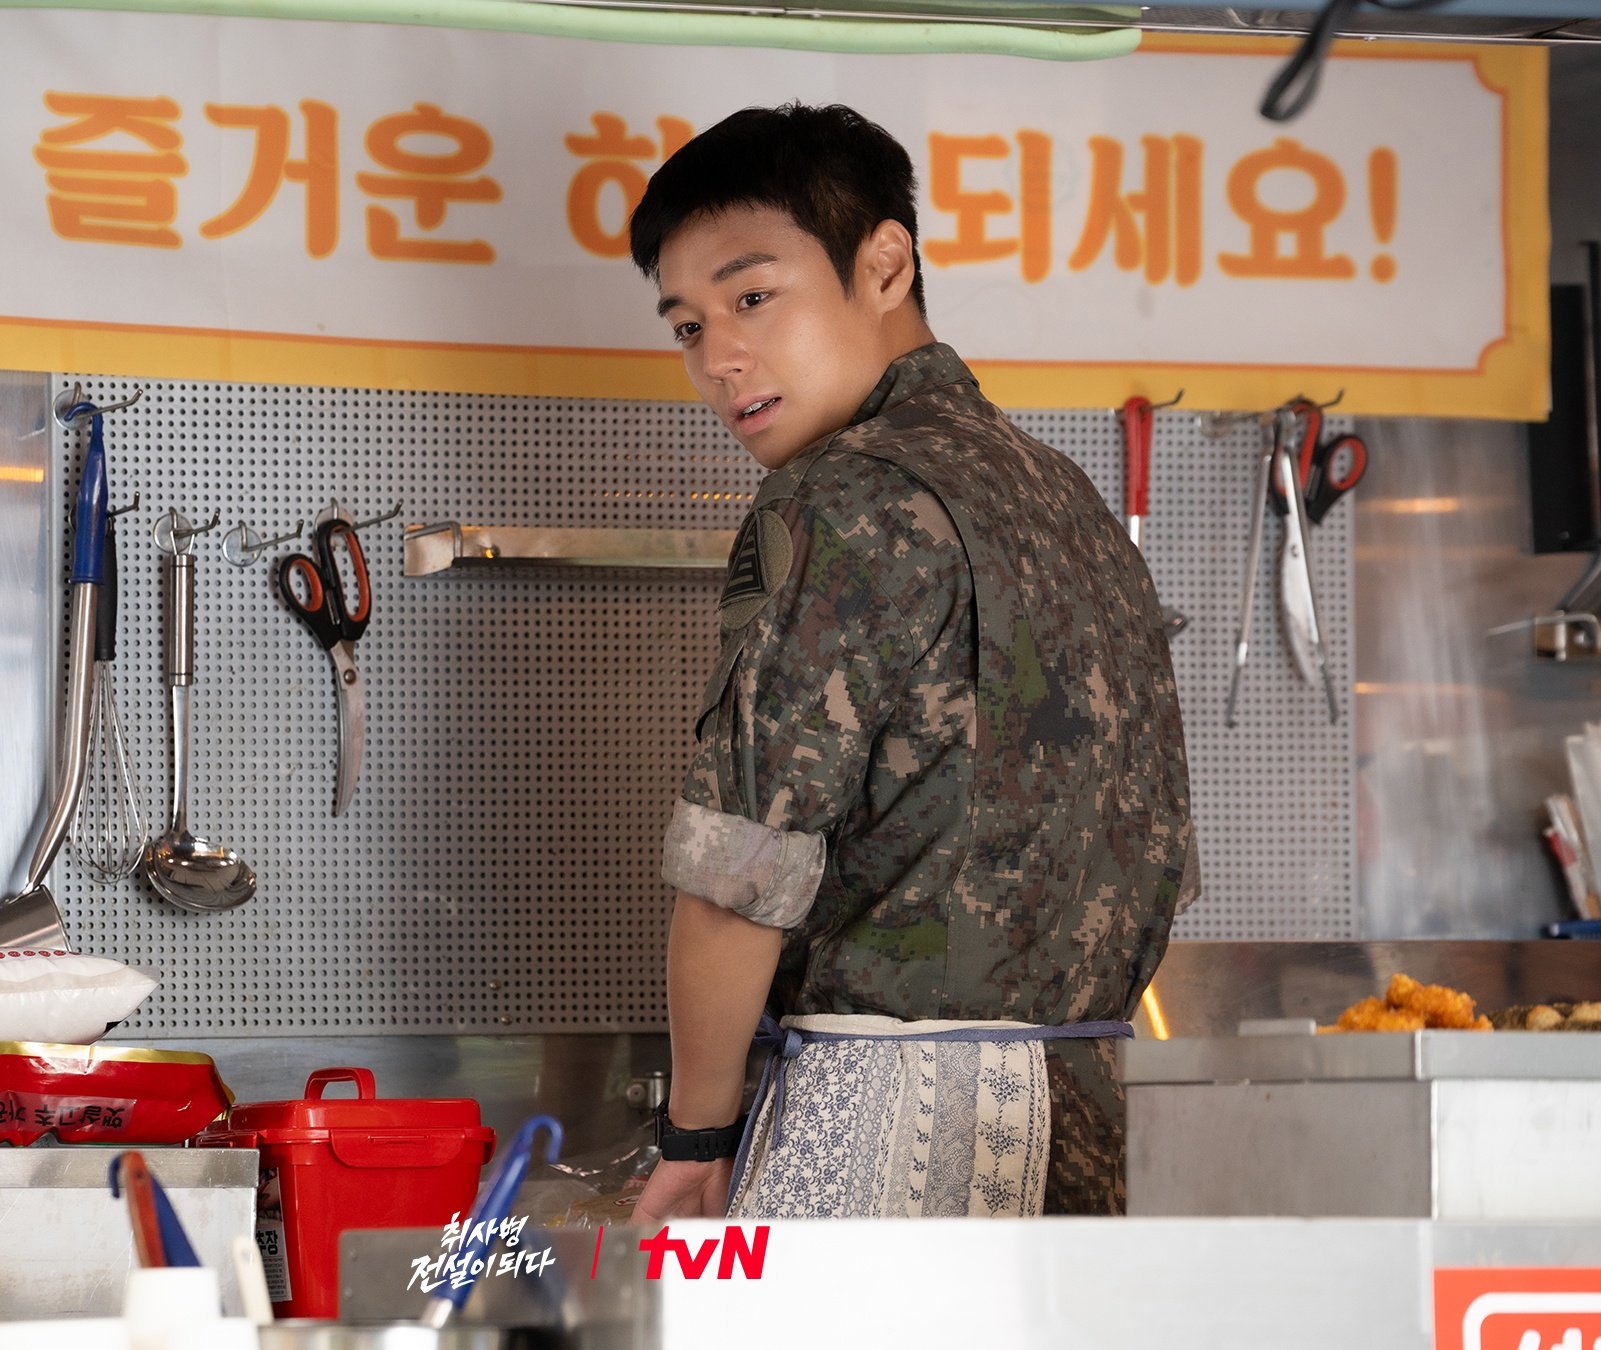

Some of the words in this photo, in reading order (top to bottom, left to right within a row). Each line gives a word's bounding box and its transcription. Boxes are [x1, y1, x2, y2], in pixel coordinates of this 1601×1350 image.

[32, 90, 503, 265] 즐거운
[563, 109, 696, 260] 하
[922, 127, 1400, 289] 되세요!
[34, 1104, 125, 1128] 햇살고추
[255, 1229, 278, 1256] 추장
